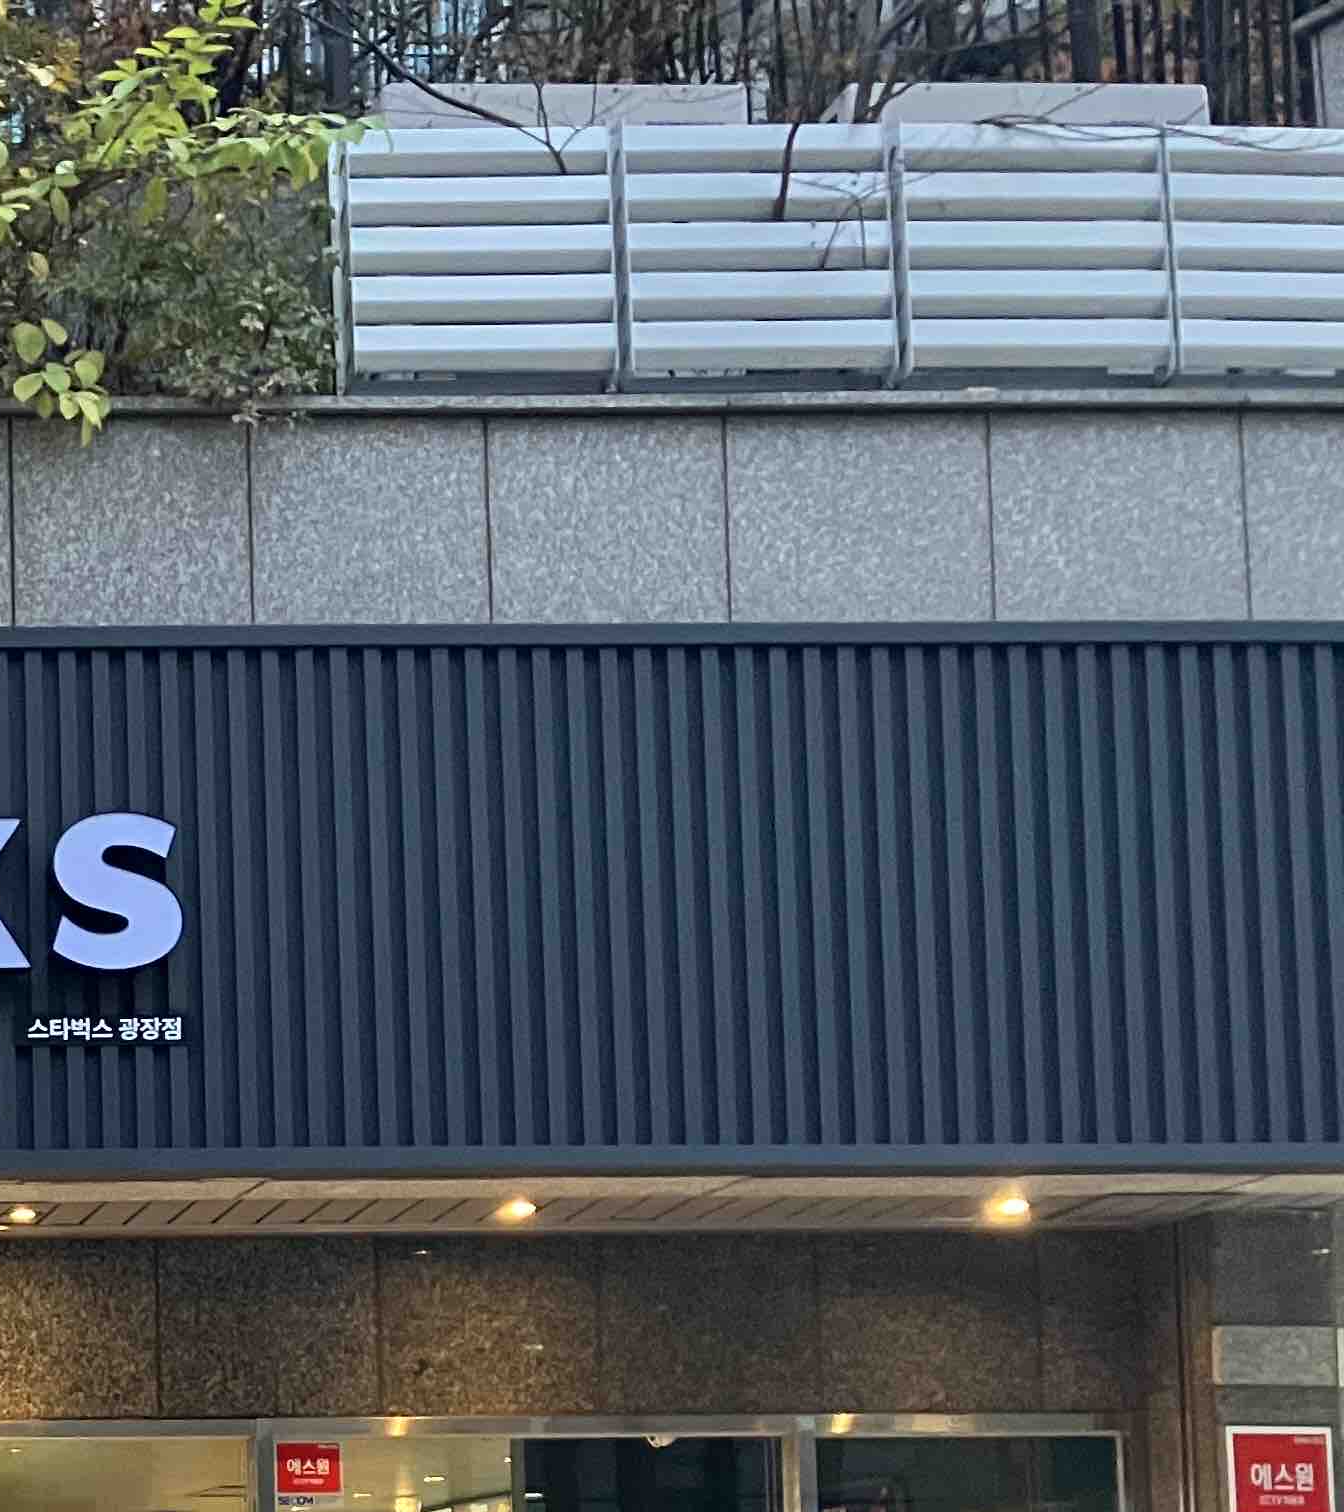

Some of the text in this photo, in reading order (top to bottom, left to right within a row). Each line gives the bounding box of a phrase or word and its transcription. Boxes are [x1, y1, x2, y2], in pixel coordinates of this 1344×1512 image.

[27, 1017, 182, 1040] 스타벅스 광장점
[286, 1457, 330, 1476] 에스원
[1250, 1462, 1314, 1492] 에스원
